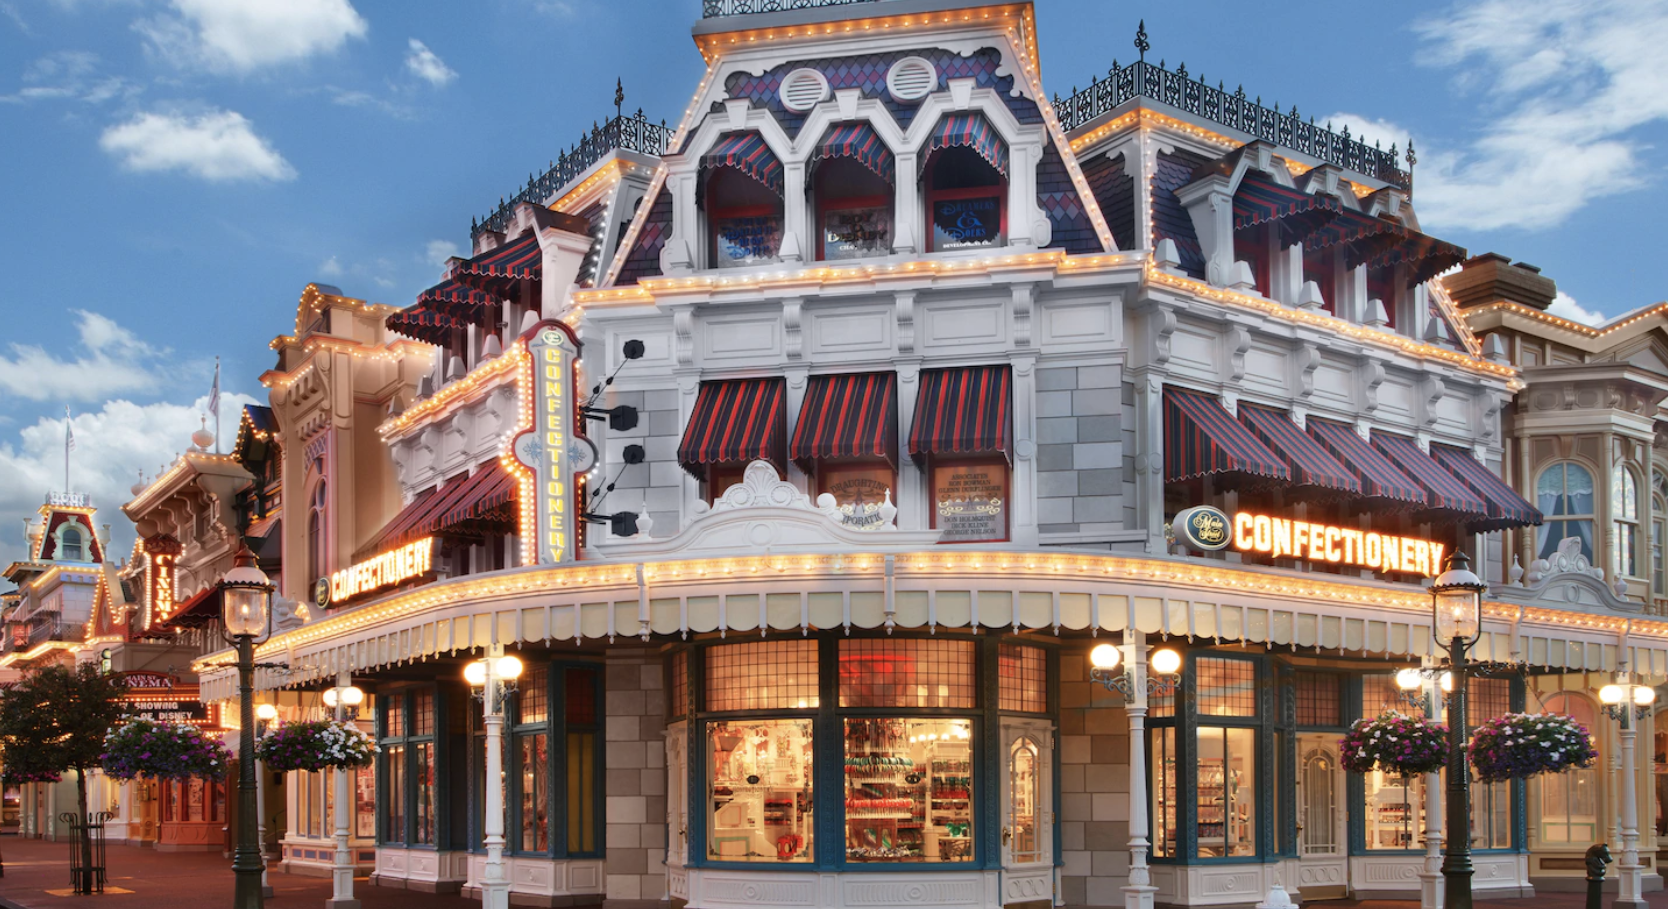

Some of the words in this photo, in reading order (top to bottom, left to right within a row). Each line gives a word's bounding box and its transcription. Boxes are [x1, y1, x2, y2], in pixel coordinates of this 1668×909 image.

[946, 226, 986, 240] DOERS
[545, 348, 566, 563] CONFECTIONERY
[830, 479, 889, 494] DRAUGHTING
[1193, 511, 1223, 530] Main
[1234, 511, 1444, 579] CONFECTIONERY
[331, 536, 433, 602] CONFECTIONERY
[155, 554, 173, 623] CINEMA
[134, 702, 178, 710] SHOWING
[140, 712, 153, 720] OF
[159, 711, 193, 720] DISNEY
